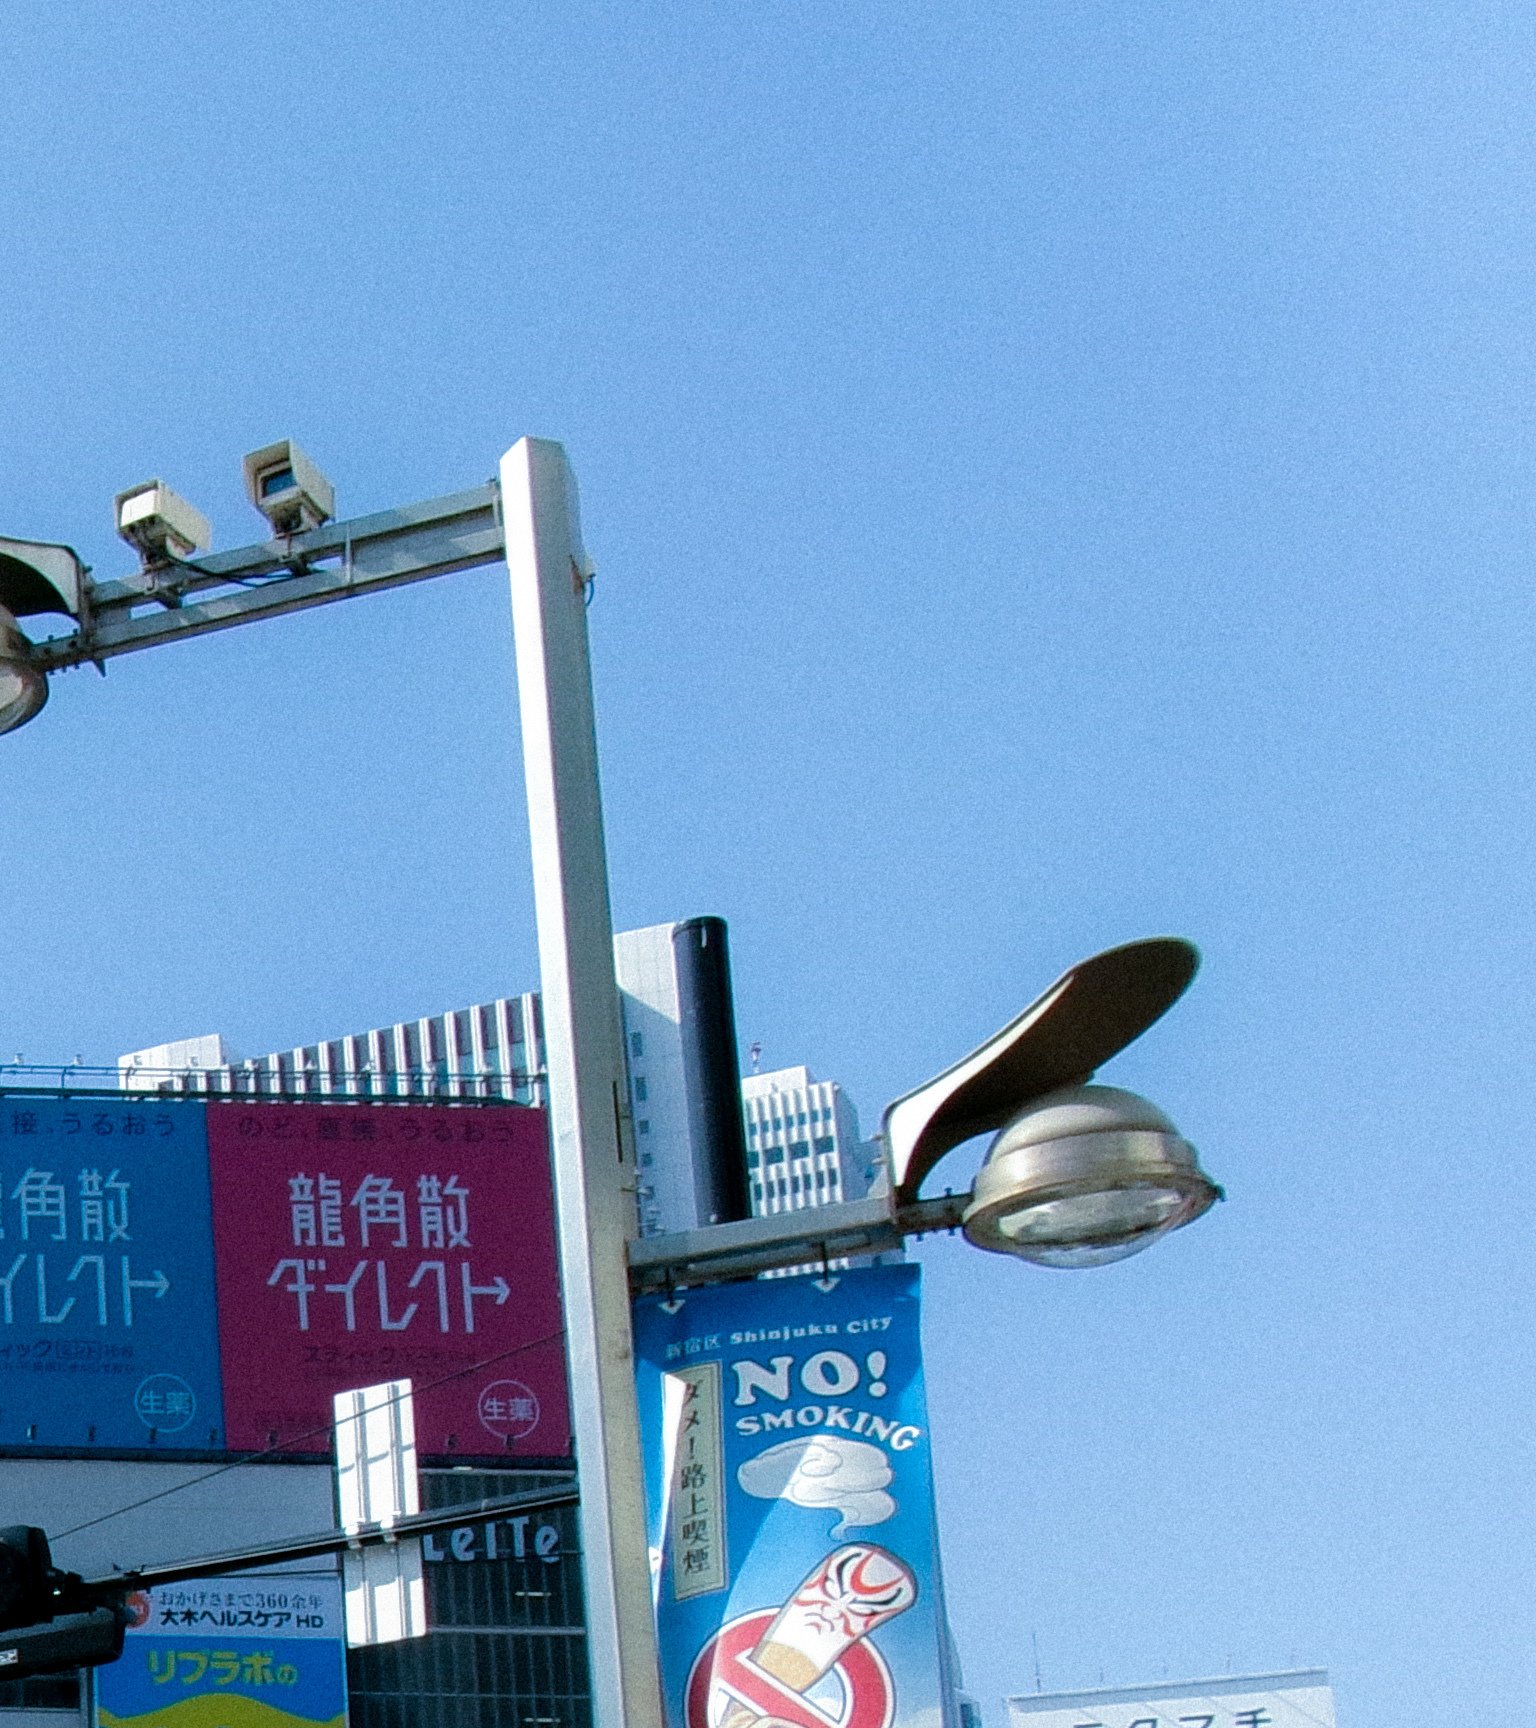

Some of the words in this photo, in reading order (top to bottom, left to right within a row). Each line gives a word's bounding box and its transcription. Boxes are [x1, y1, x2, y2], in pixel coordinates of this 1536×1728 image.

[288, 1171, 473, 1248] 龍角散
[267, 1258, 511, 1334] ダイレクト
[730, 1324, 839, 1345] Shinjuku
[846, 1315, 893, 1335] City
[732, 1350, 888, 1406] NO!
[735, 1405, 921, 1451] SMOKING
[159, 1609, 292, 1628] 大木ヘルスケア
[296, 1614, 324, 1628] HD
